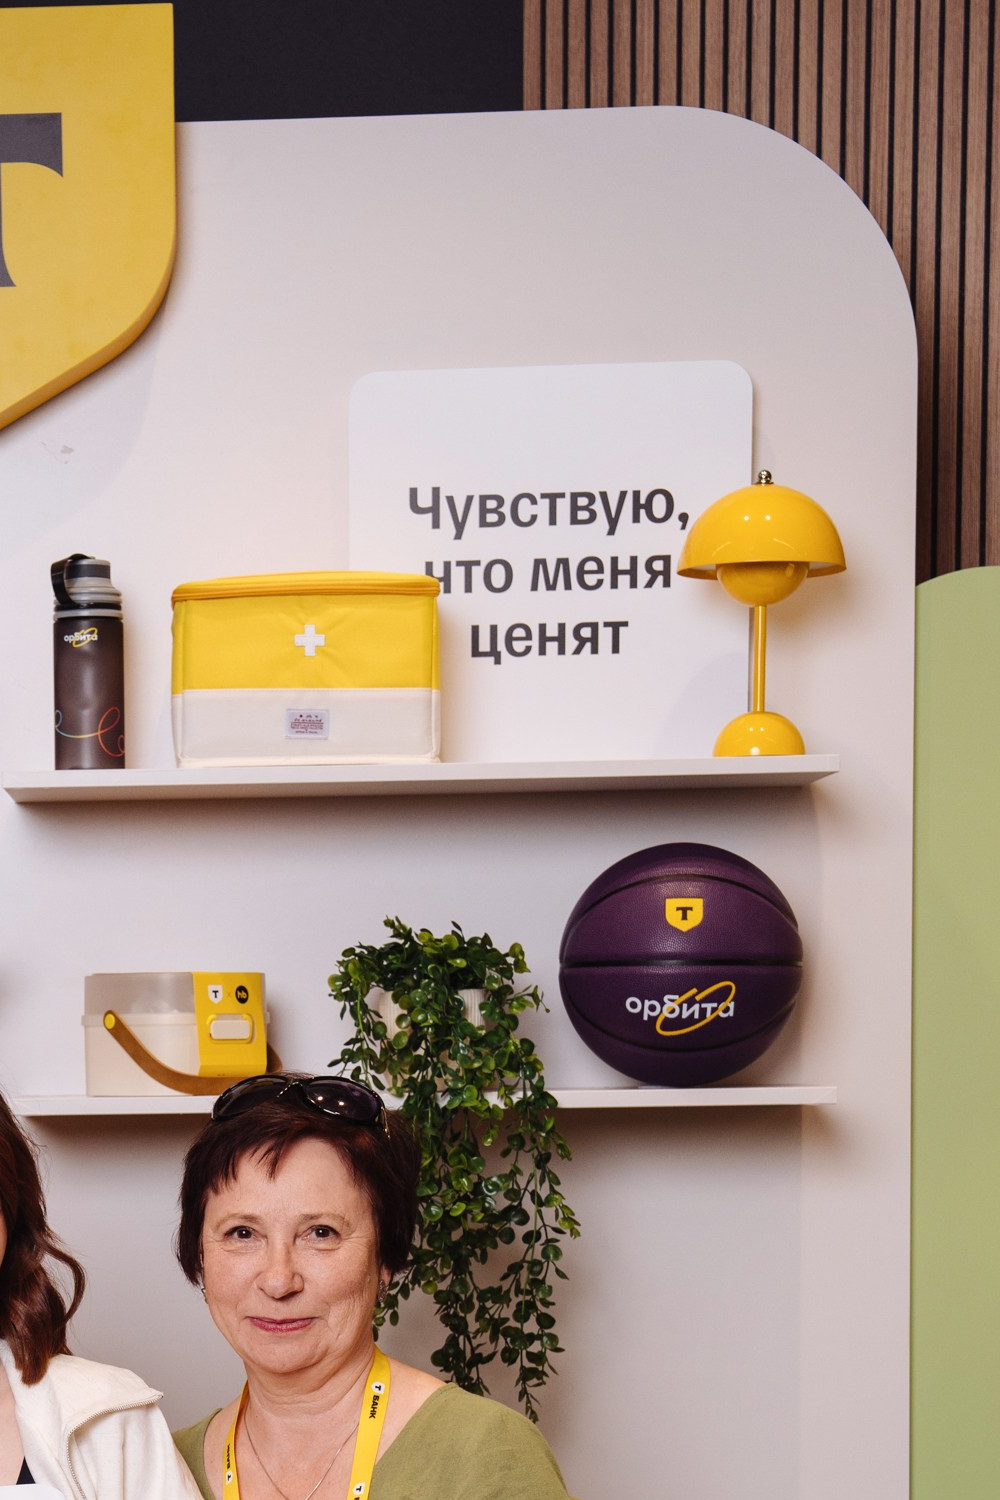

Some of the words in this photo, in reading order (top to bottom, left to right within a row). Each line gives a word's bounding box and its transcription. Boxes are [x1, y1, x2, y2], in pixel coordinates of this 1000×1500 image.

[408, 486, 690, 541] Чувствую,
[424, 558, 515, 595] что
[529, 554, 672, 593] меня
[470, 620, 630, 666] ценят
[675, 906, 694, 921] Т
[624, 994, 736, 1022] орбита
[369, 1394, 380, 1420] БАНК
